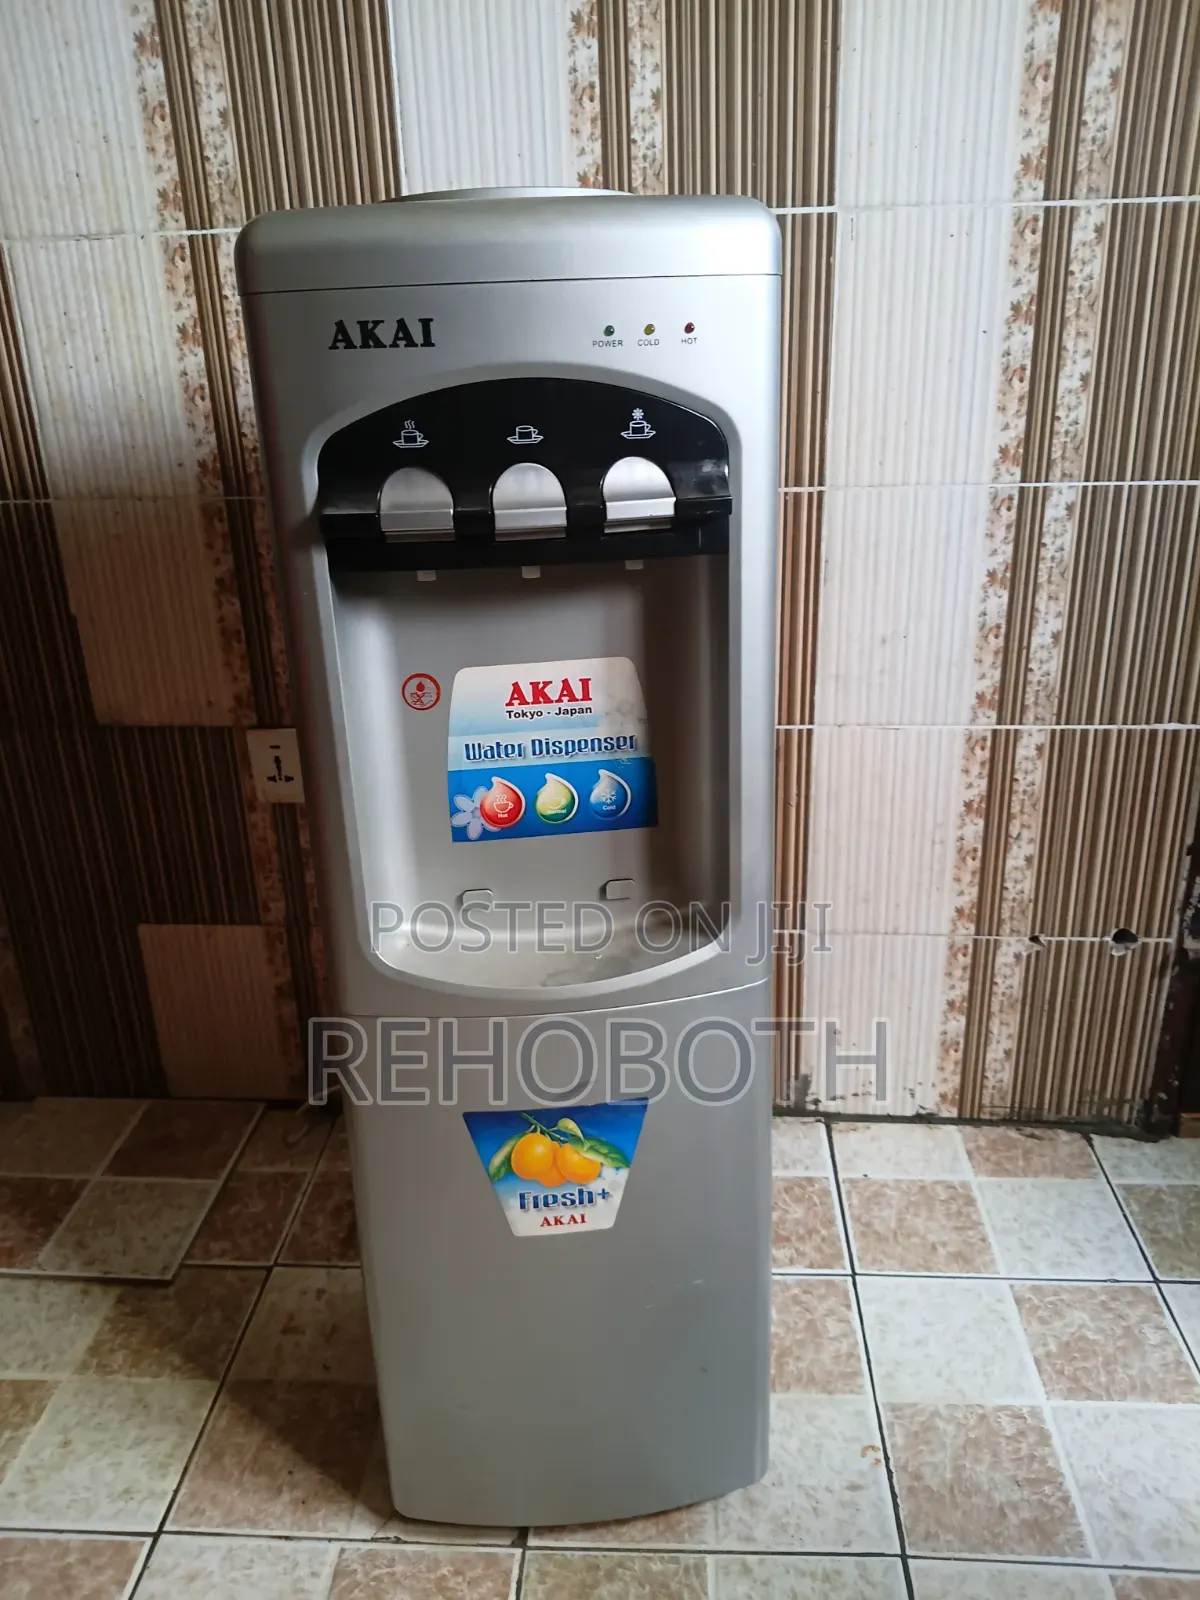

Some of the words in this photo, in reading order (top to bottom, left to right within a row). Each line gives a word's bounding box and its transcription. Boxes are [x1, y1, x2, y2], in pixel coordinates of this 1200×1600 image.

[328, 317, 436, 351] AKAI
[681, 337, 698, 345] HOT
[592, 340, 624, 348] POWER
[637, 339, 660, 347] COLD
[505, 678, 593, 707] AKAI
[506, 709, 543, 719] Tokyo
[554, 706, 593, 718] Japan
[464, 741, 526, 761] Water
[531, 734, 637, 758] Dispenser
[519, 1187, 610, 1210] Fresh+
[540, 1213, 587, 1227] AKAI
